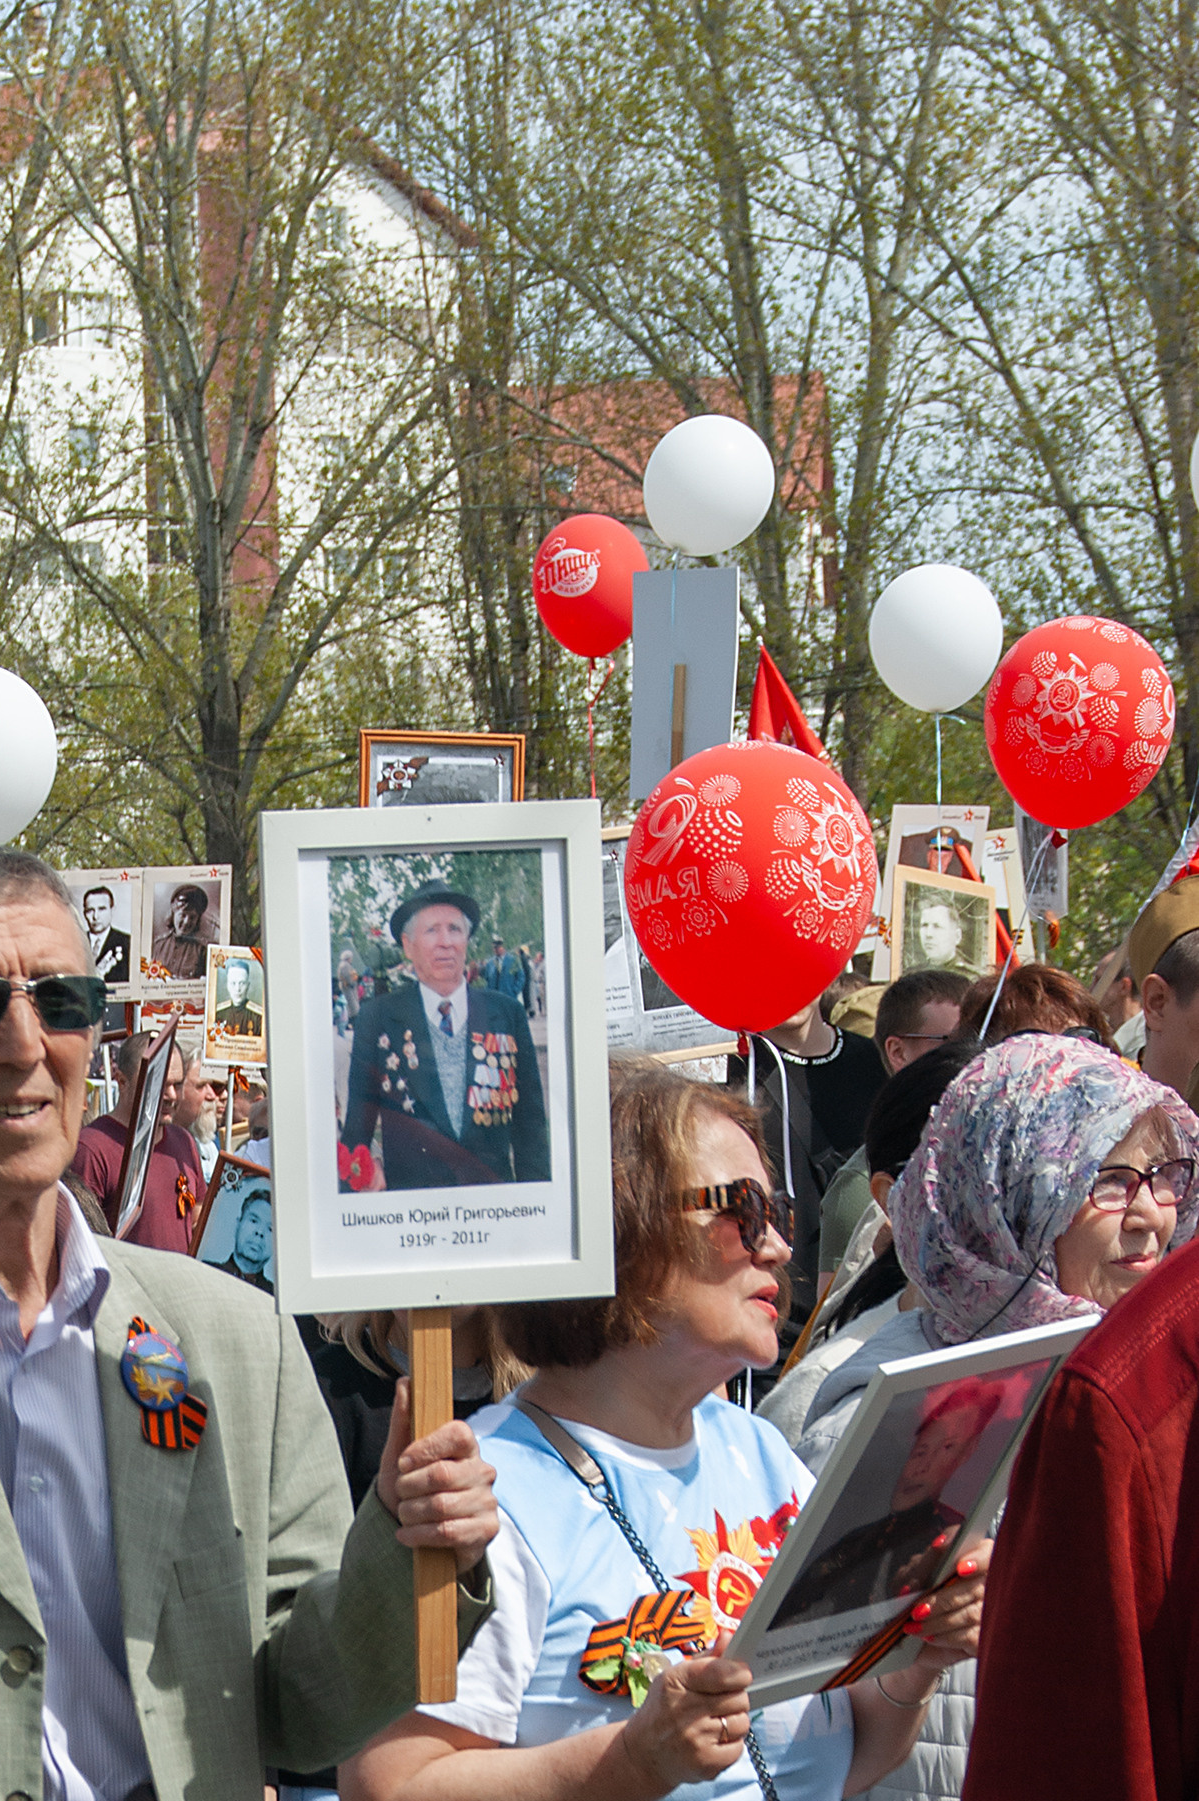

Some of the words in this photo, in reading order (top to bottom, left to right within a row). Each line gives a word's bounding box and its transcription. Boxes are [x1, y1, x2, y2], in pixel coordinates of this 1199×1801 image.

[537, 551, 601, 594] ПИЦЦА
[341, 1212, 403, 1227] Шишков
[408, 1206, 450, 1226] Юрий
[454, 1204, 546, 1223] Григорьевич
[399, 1234, 437, 1247] 1919г
[451, 1230, 490, 1245] 2011г
